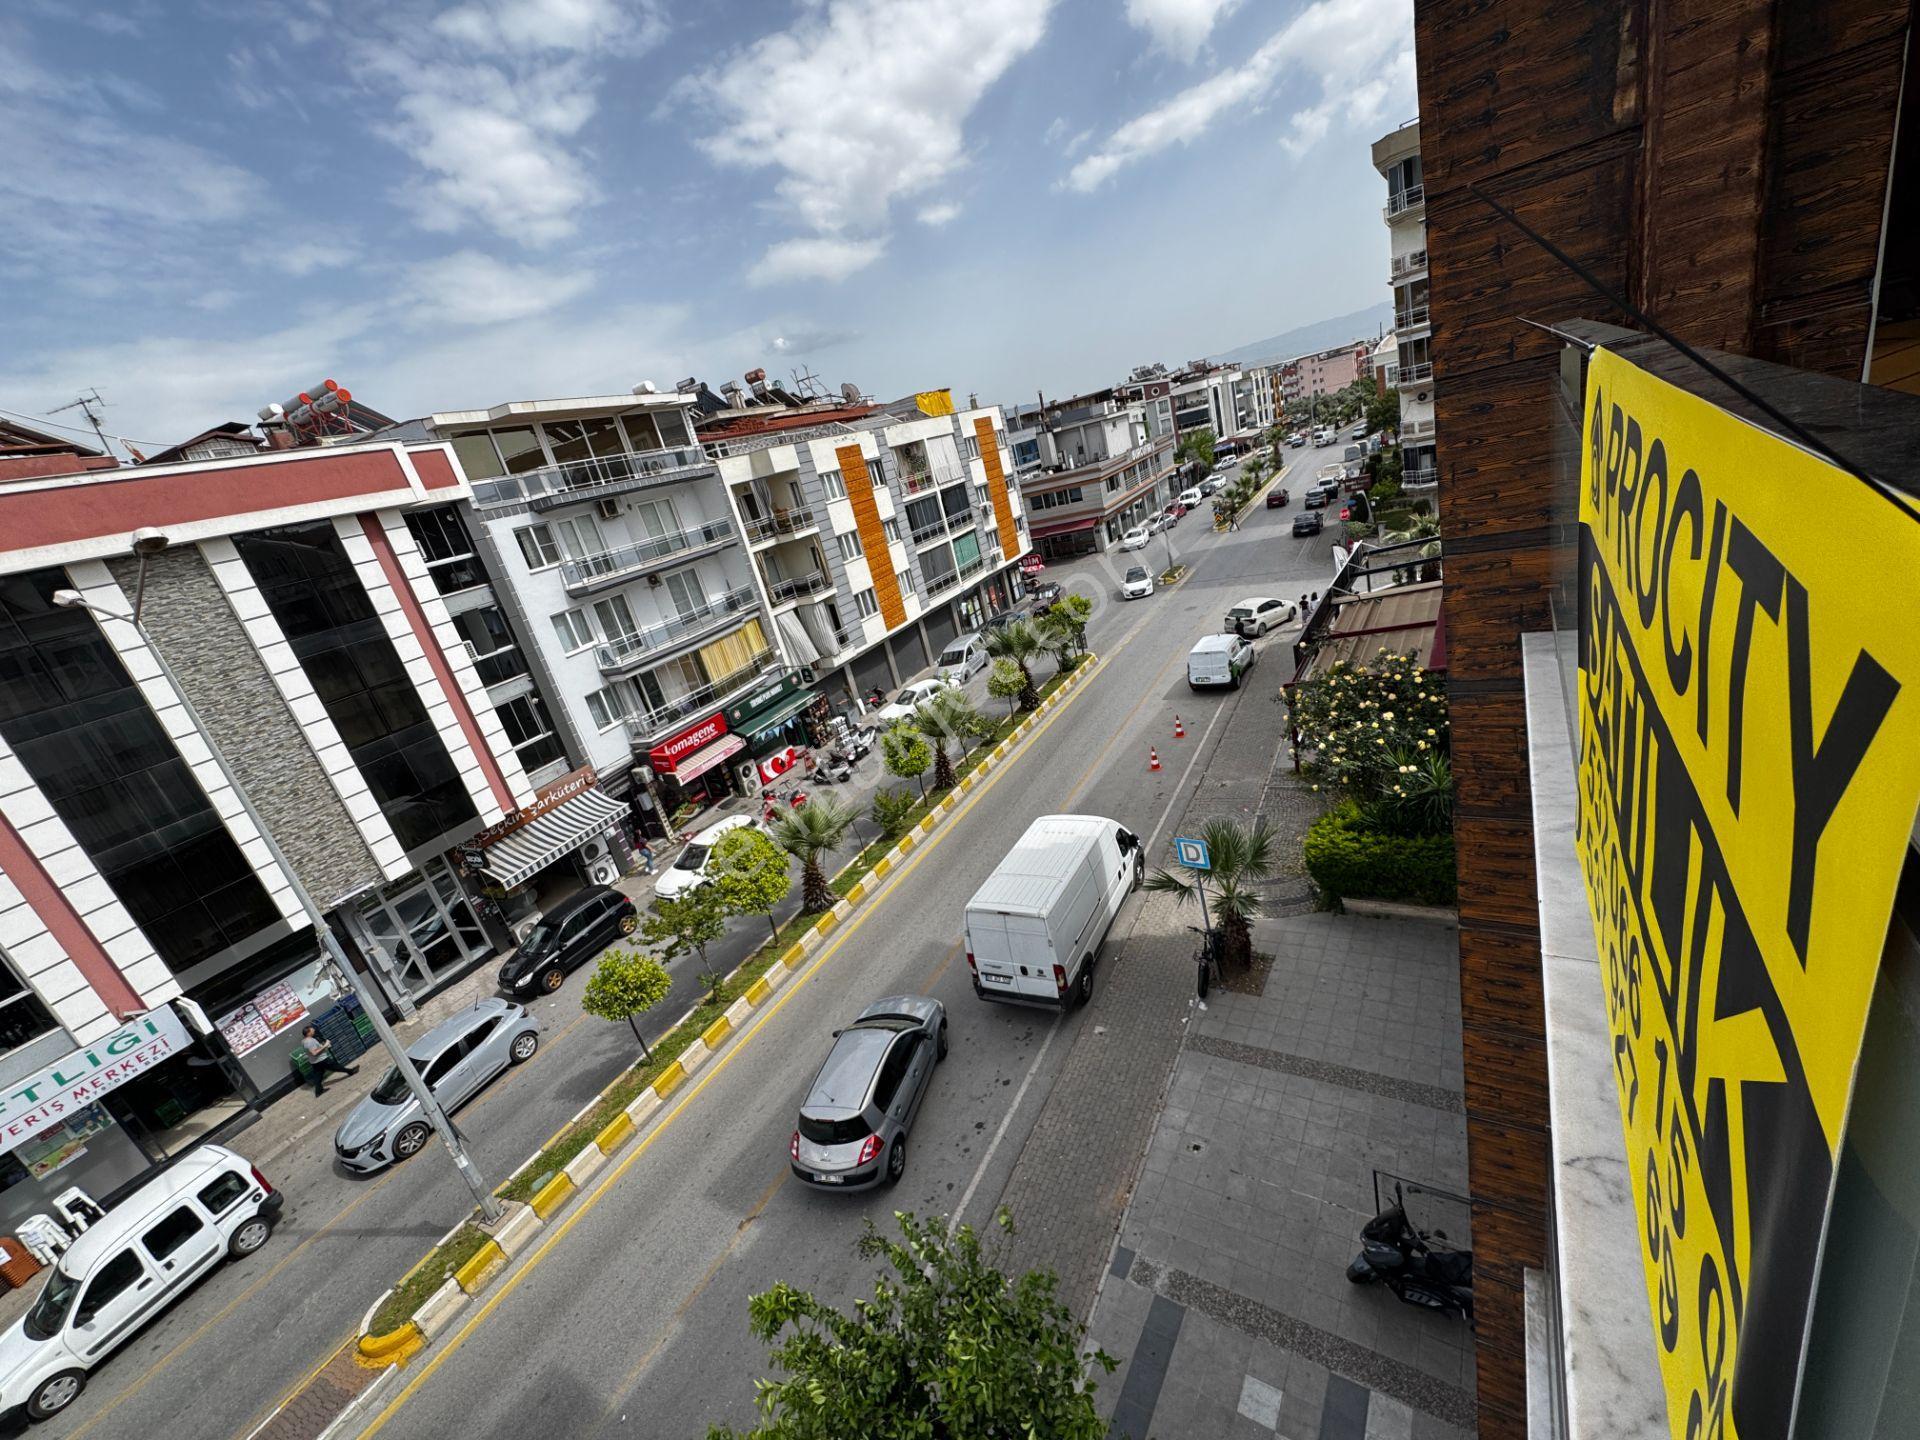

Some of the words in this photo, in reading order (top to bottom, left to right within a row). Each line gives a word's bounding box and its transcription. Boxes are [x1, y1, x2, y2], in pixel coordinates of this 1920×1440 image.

[1022, 556, 1039, 566] BİM
[1605, 402, 1902, 974] PROCITY
[664, 722, 716, 756] komagene
[528, 773, 586, 816] Şarküteri
[1184, 844, 1201, 863] D
[1588, 561, 1788, 1318] SATILIK
[1611, 842, 1641, 1040] 066
[1654, 1036, 1689, 1240] 15
[73, 1038, 170, 1100] MERKEZİ
